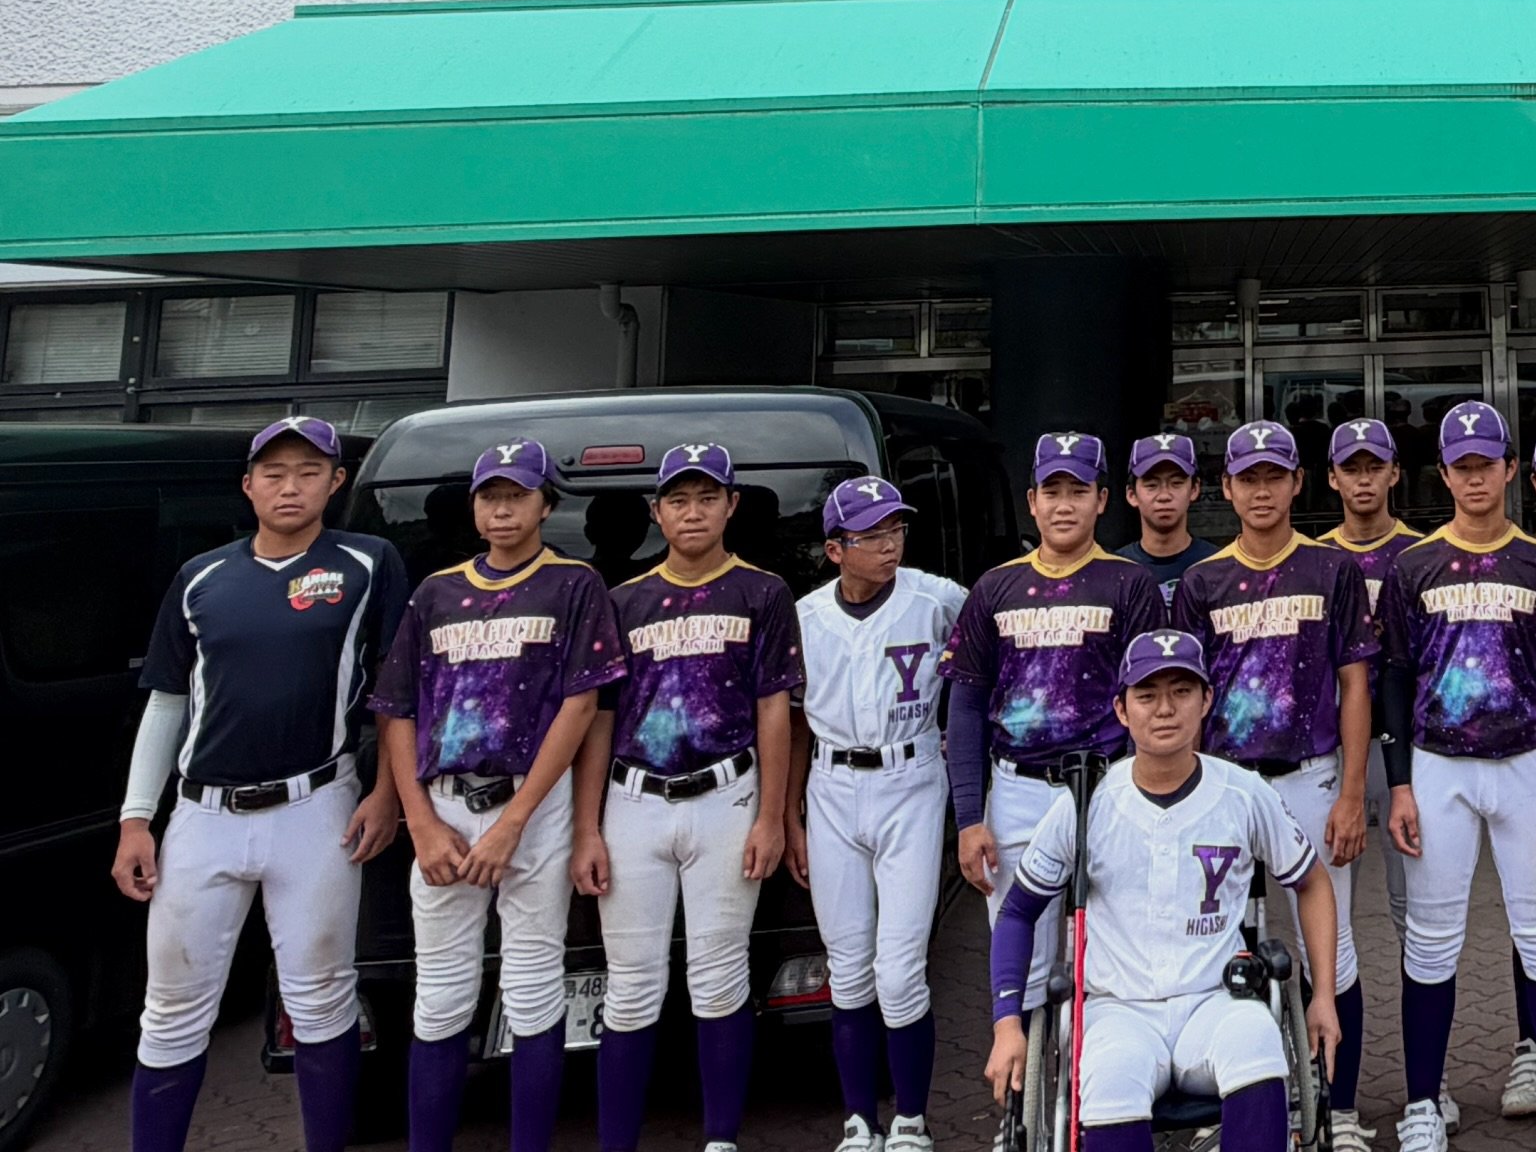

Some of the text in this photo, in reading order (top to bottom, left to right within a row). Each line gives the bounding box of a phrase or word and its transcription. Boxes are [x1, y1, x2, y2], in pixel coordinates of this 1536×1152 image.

[1349, 423, 1372, 440] Y
[1458, 414, 1480, 435] Y
[1056, 435, 1079, 455] Y
[1153, 434, 1176, 449] Y
[1249, 428, 1273, 449] Y
[497, 444, 523, 463] Y
[684, 445, 709, 462] Y
[857, 482, 883, 501] Y
[994, 606, 1113, 637] YAMAGUCHI
[1210, 596, 1324, 644] YAMAGUCHI
[431, 617, 556, 654] YAMAGUCHI
[629, 615, 750, 653] YAMAGUCHI
[1154, 635, 1180, 656] Y
[885, 643, 931, 703] Y
[1192, 844, 1241, 915] Y
[579, 977, 608, 998] 48
